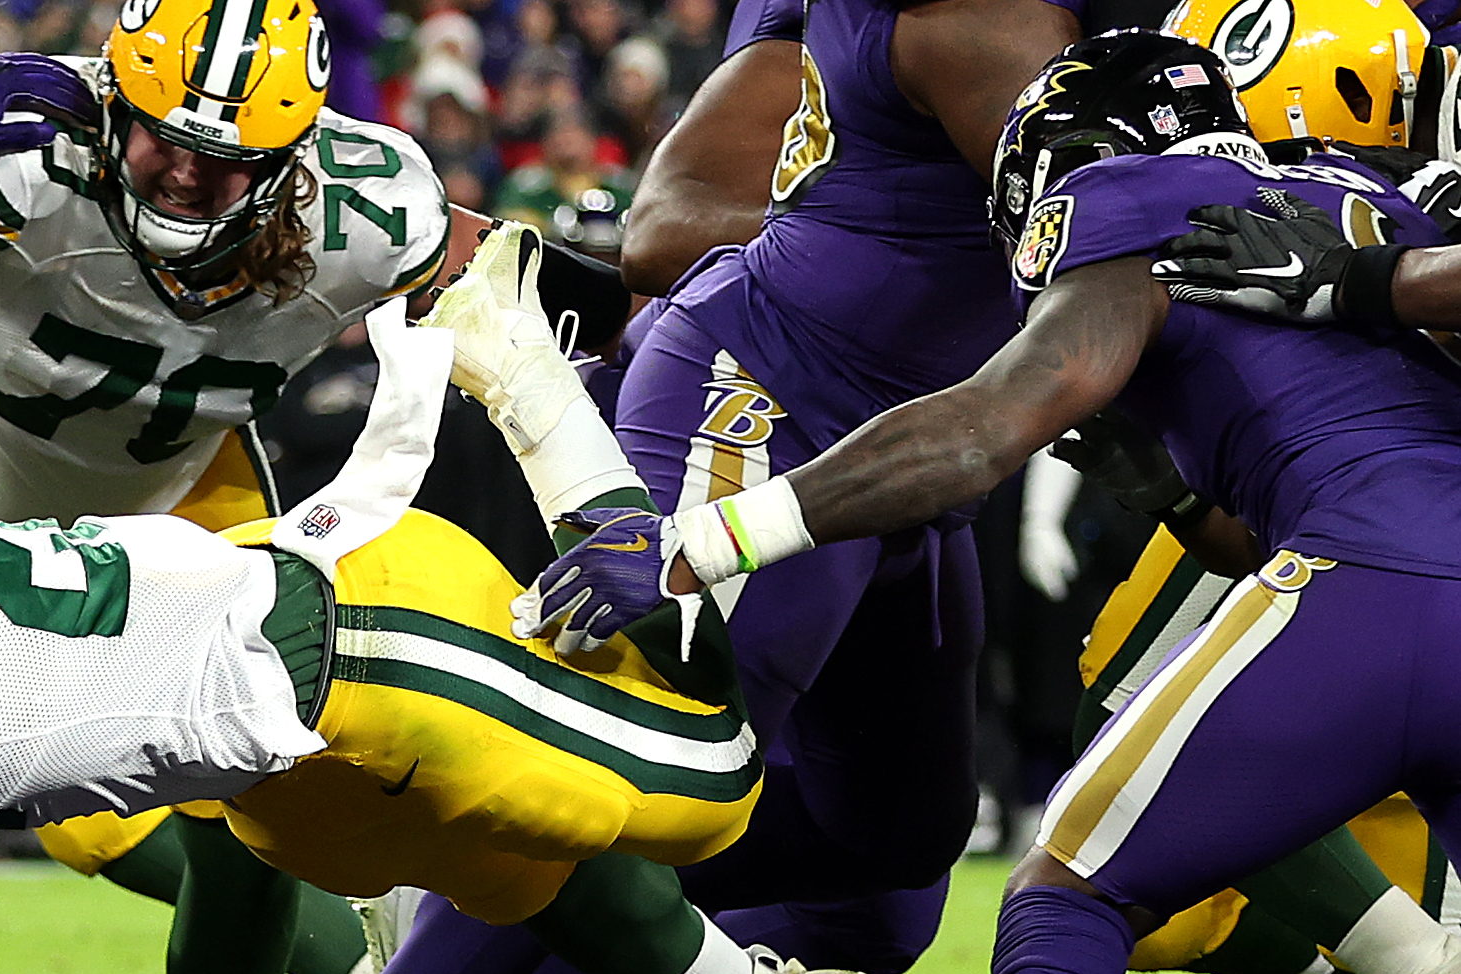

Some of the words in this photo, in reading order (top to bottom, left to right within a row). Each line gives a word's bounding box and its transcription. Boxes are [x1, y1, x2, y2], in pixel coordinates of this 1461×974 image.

[1197, 142, 1266, 163] RAVEN
[316, 126, 407, 252] 70
[698, 379, 788, 446] B
[310, 507, 339, 530] NFL
